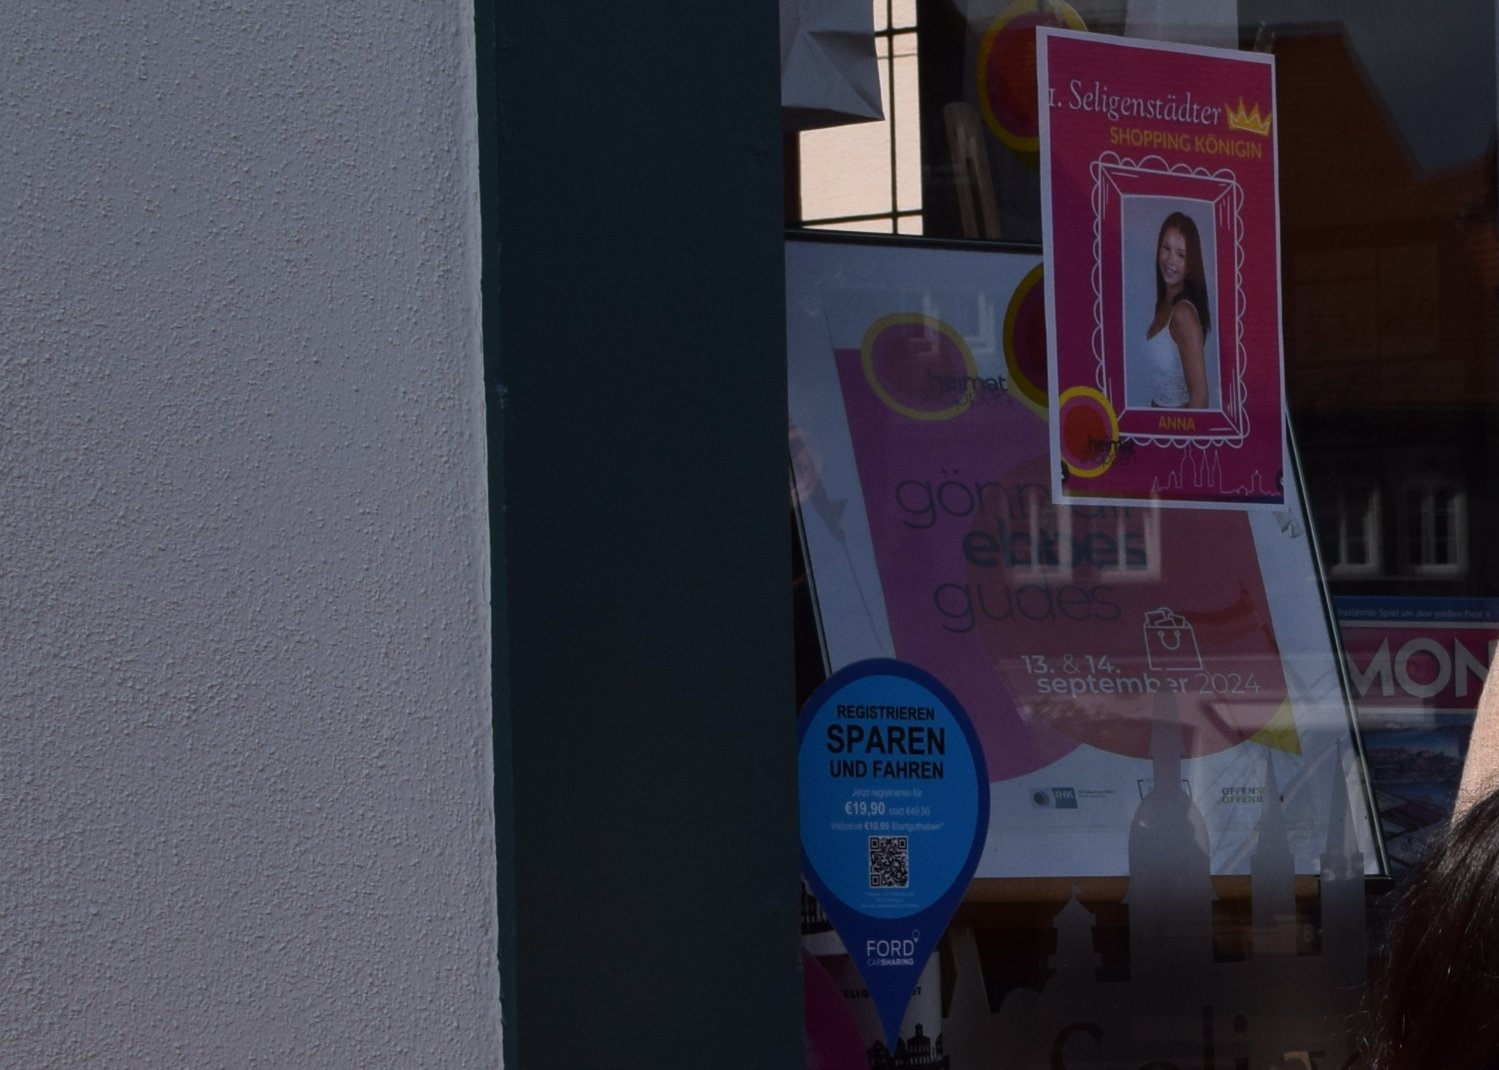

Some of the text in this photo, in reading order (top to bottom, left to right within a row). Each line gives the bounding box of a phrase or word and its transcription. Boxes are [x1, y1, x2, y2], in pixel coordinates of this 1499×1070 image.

[1069, 79, 1222, 126] Seligenstädter
[1110, 126, 1263, 159] SHOPPING KÖNIGIN
[1158, 416, 1196, 431] ANNA
[963, 519, 1148, 568] ebbes
[934, 583, 1122, 633] gudes
[1021, 653, 1121, 674] 13. & 14.
[1037, 673, 1261, 698] september 2024
[837, 705, 935, 721] REGISTRIEREN
[827, 724, 945, 755] SPAREN
[830, 760, 944, 779] UND FAHREN
[1055, 788, 1074, 800] IHK
[845, 801, 886, 817] €19,90
[867, 940, 914, 957] FORD
[868, 957, 914, 967] CARSHARING
